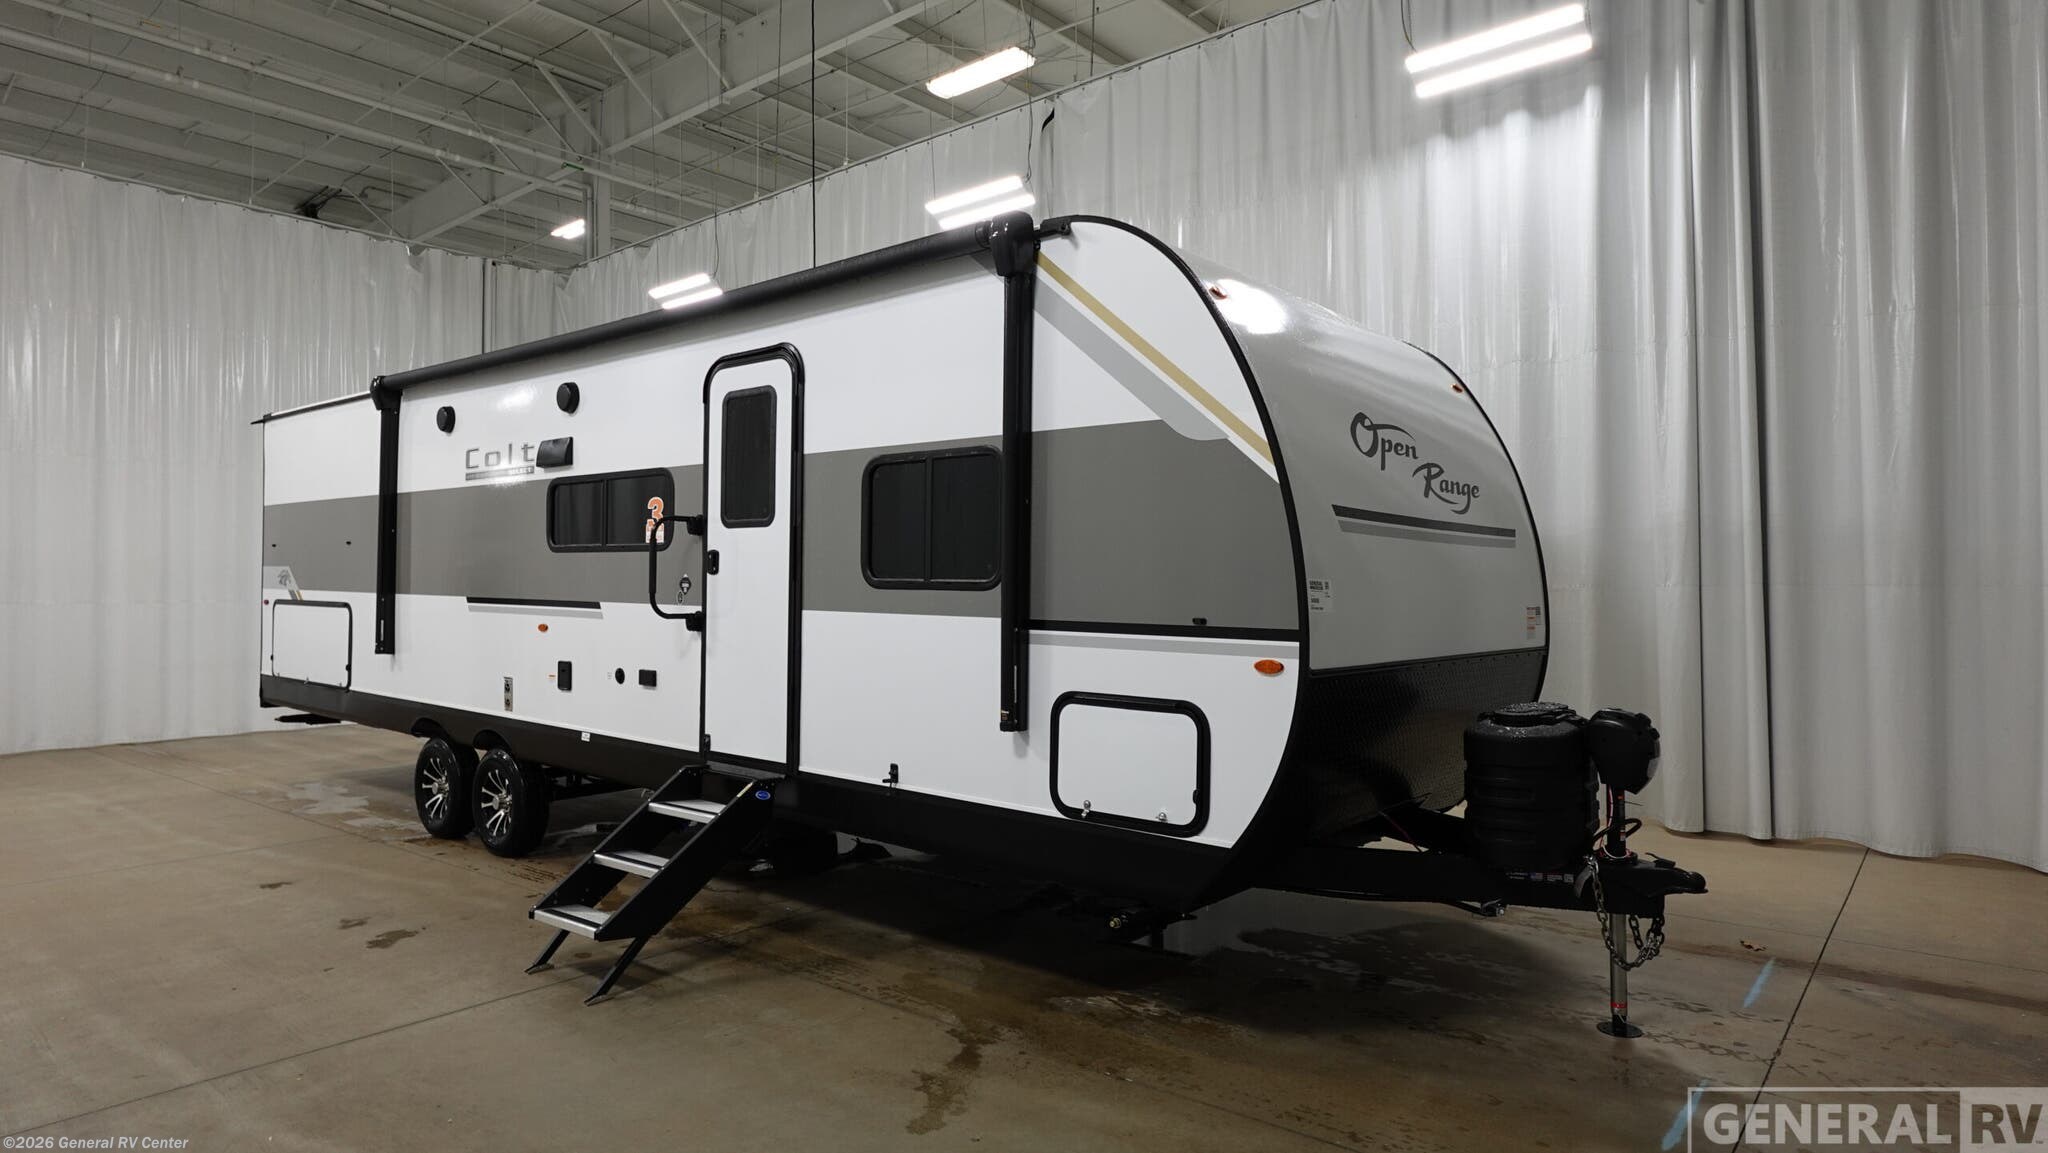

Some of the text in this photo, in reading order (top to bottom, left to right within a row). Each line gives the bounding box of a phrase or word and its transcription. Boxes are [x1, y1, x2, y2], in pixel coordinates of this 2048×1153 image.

[465, 443, 535, 469] Colt
[1350, 411, 1418, 471] Open
[1412, 462, 1480, 515] Range
